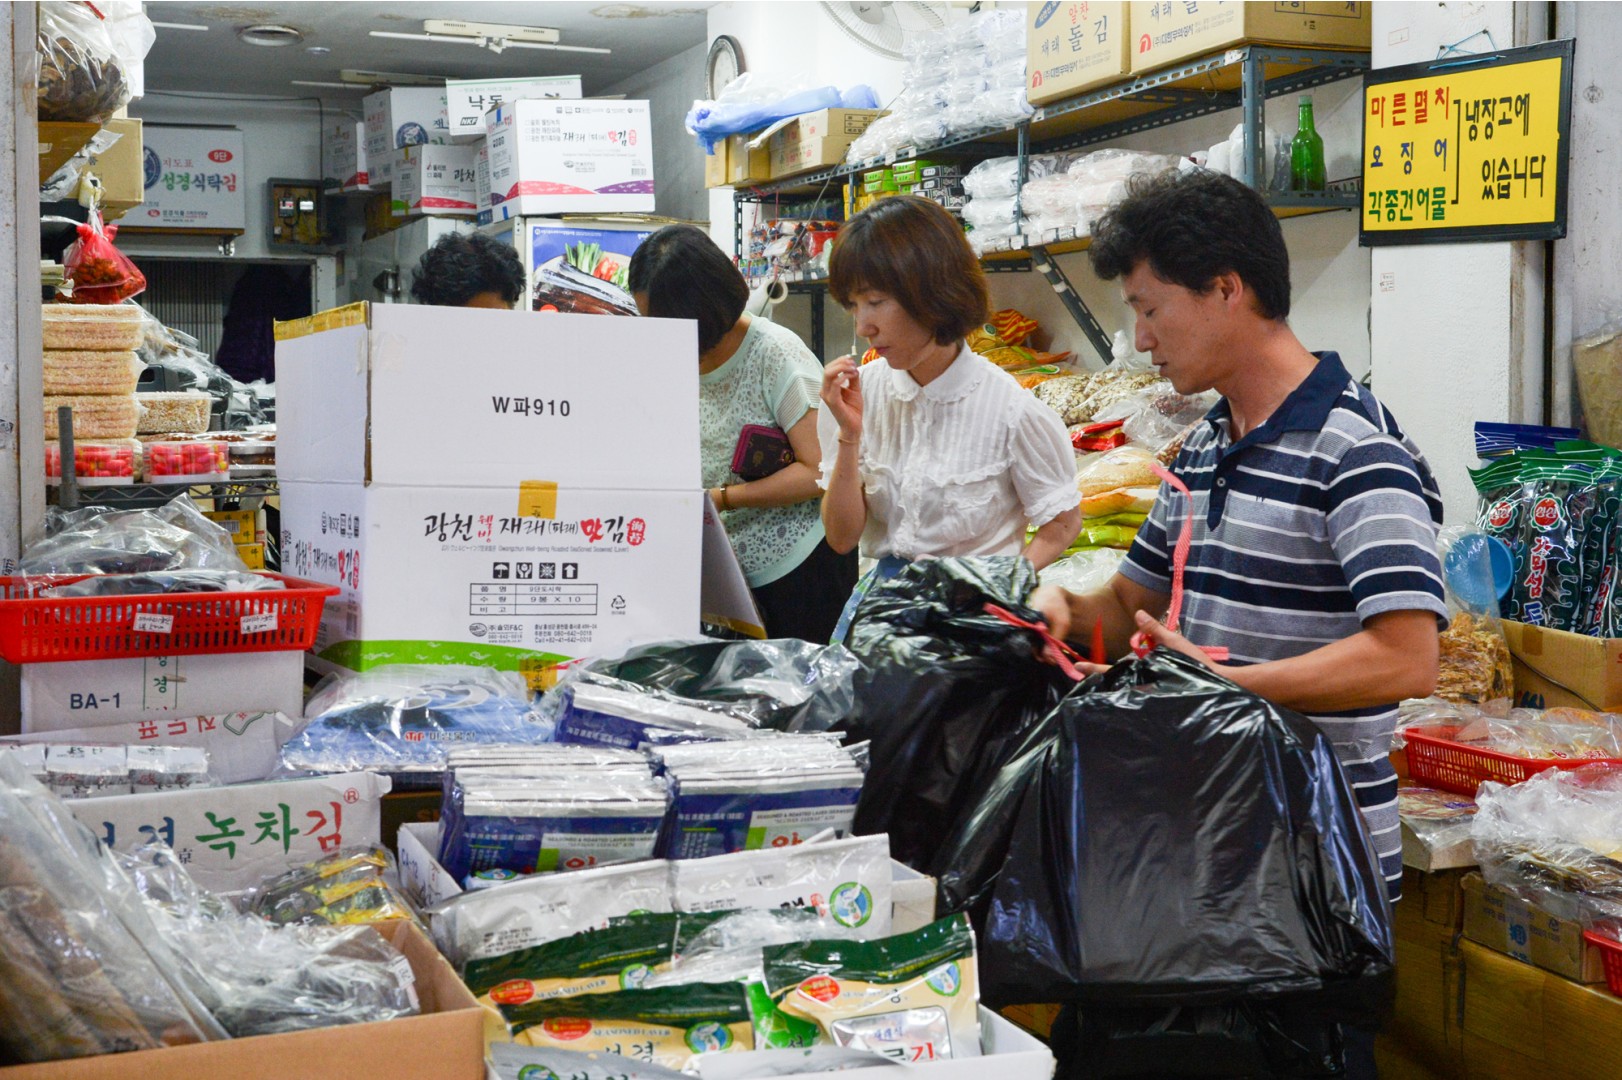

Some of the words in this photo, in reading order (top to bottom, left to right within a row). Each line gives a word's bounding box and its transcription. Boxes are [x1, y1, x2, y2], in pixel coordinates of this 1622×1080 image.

[1371, 86, 1450, 128] 마른멸치
[1465, 93, 1530, 141] 냉장고에
[1370, 138, 1448, 174] 오징어
[161, 171, 237, 193] 성경식탁김
[454, 168, 475, 182] 광천
[1481, 155, 1546, 200] 있습니다
[1368, 187, 1447, 222] 각종건어물
[492, 396, 571, 417] W파910
[424, 512, 473, 542] 광천
[499, 516, 546, 537] 재래
[547, 519, 579, 536] (파래)
[580, 515, 625, 544] 맛김
[70, 693, 122, 710] BA-1
[195, 801, 343, 861] 녹차김
[580, 979, 607, 992] LAVER
[593, 1028, 641, 1037] SEASONED
[641, 1028, 671, 1037] LAVER
